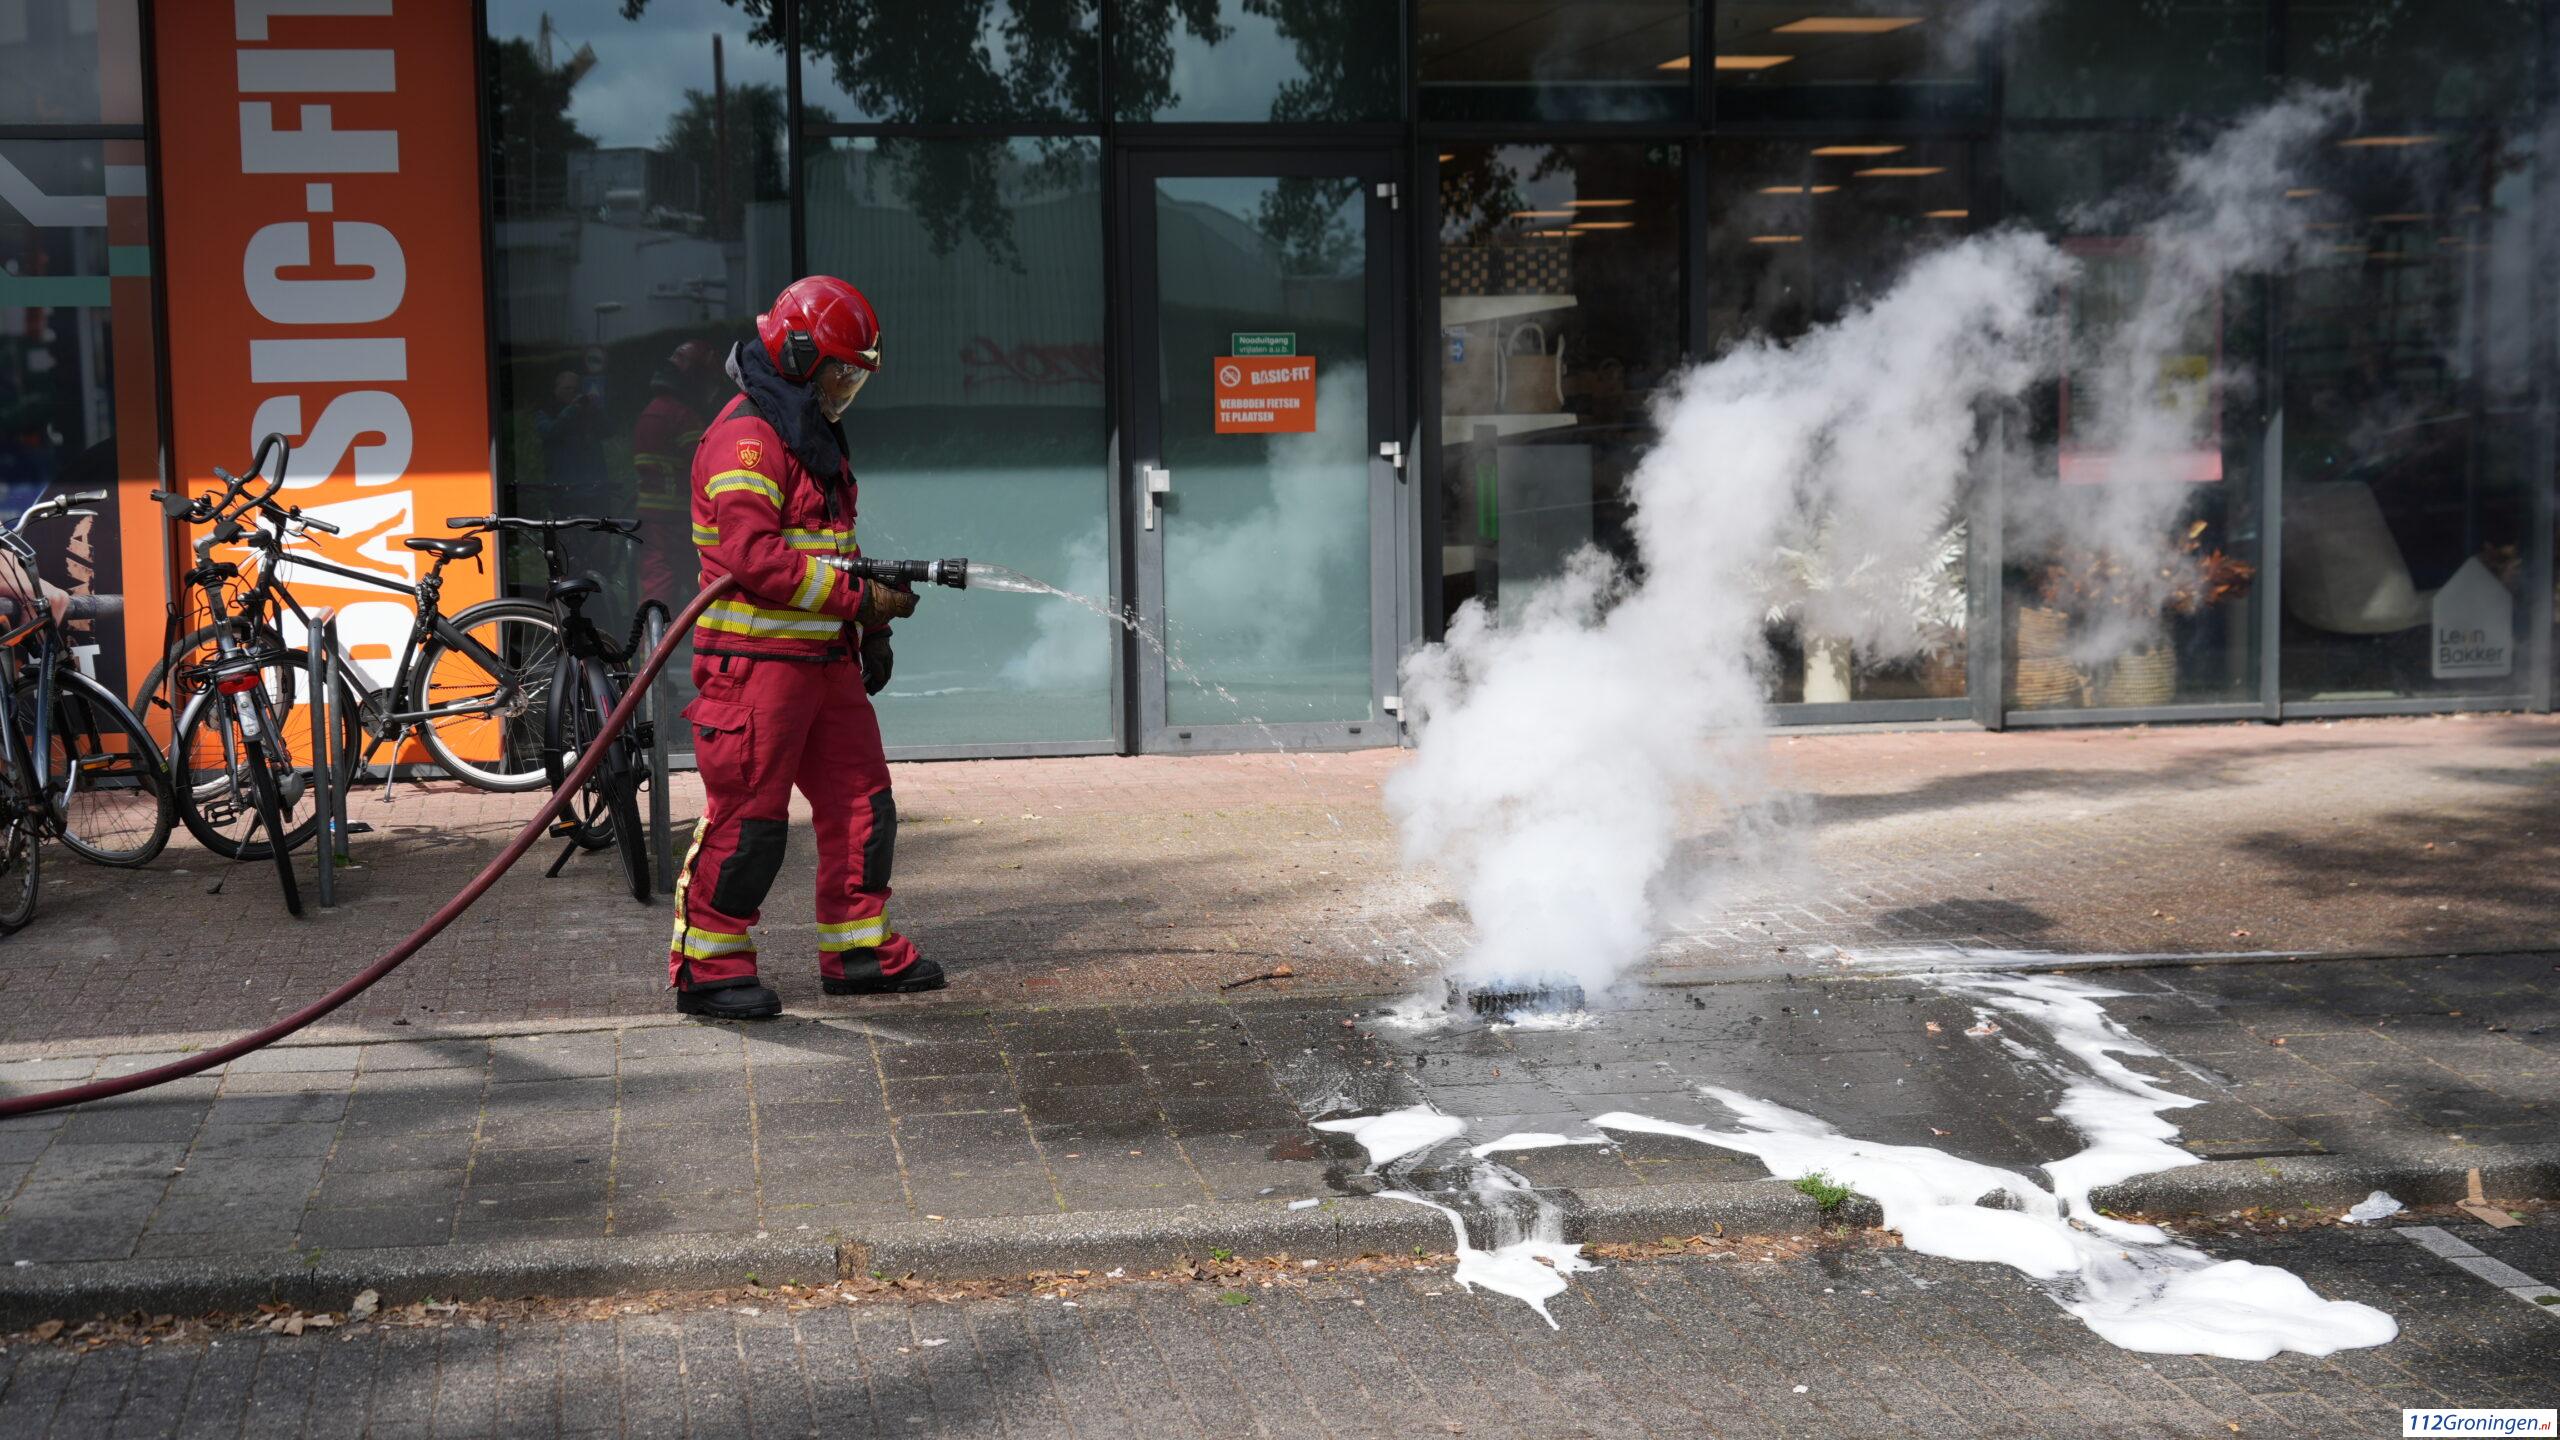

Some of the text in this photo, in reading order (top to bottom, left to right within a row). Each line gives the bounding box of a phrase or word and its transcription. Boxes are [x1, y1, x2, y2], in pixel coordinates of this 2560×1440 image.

[1239, 336, 1289, 345] Nooduitgang
[1251, 366, 1311, 385] BASIC-FIT
[1220, 397, 1300, 409] VERBODEN FIETSEN
[1220, 411, 1275, 422] TE PLAATSEN
[2440, 646, 2504, 664] Bakker
